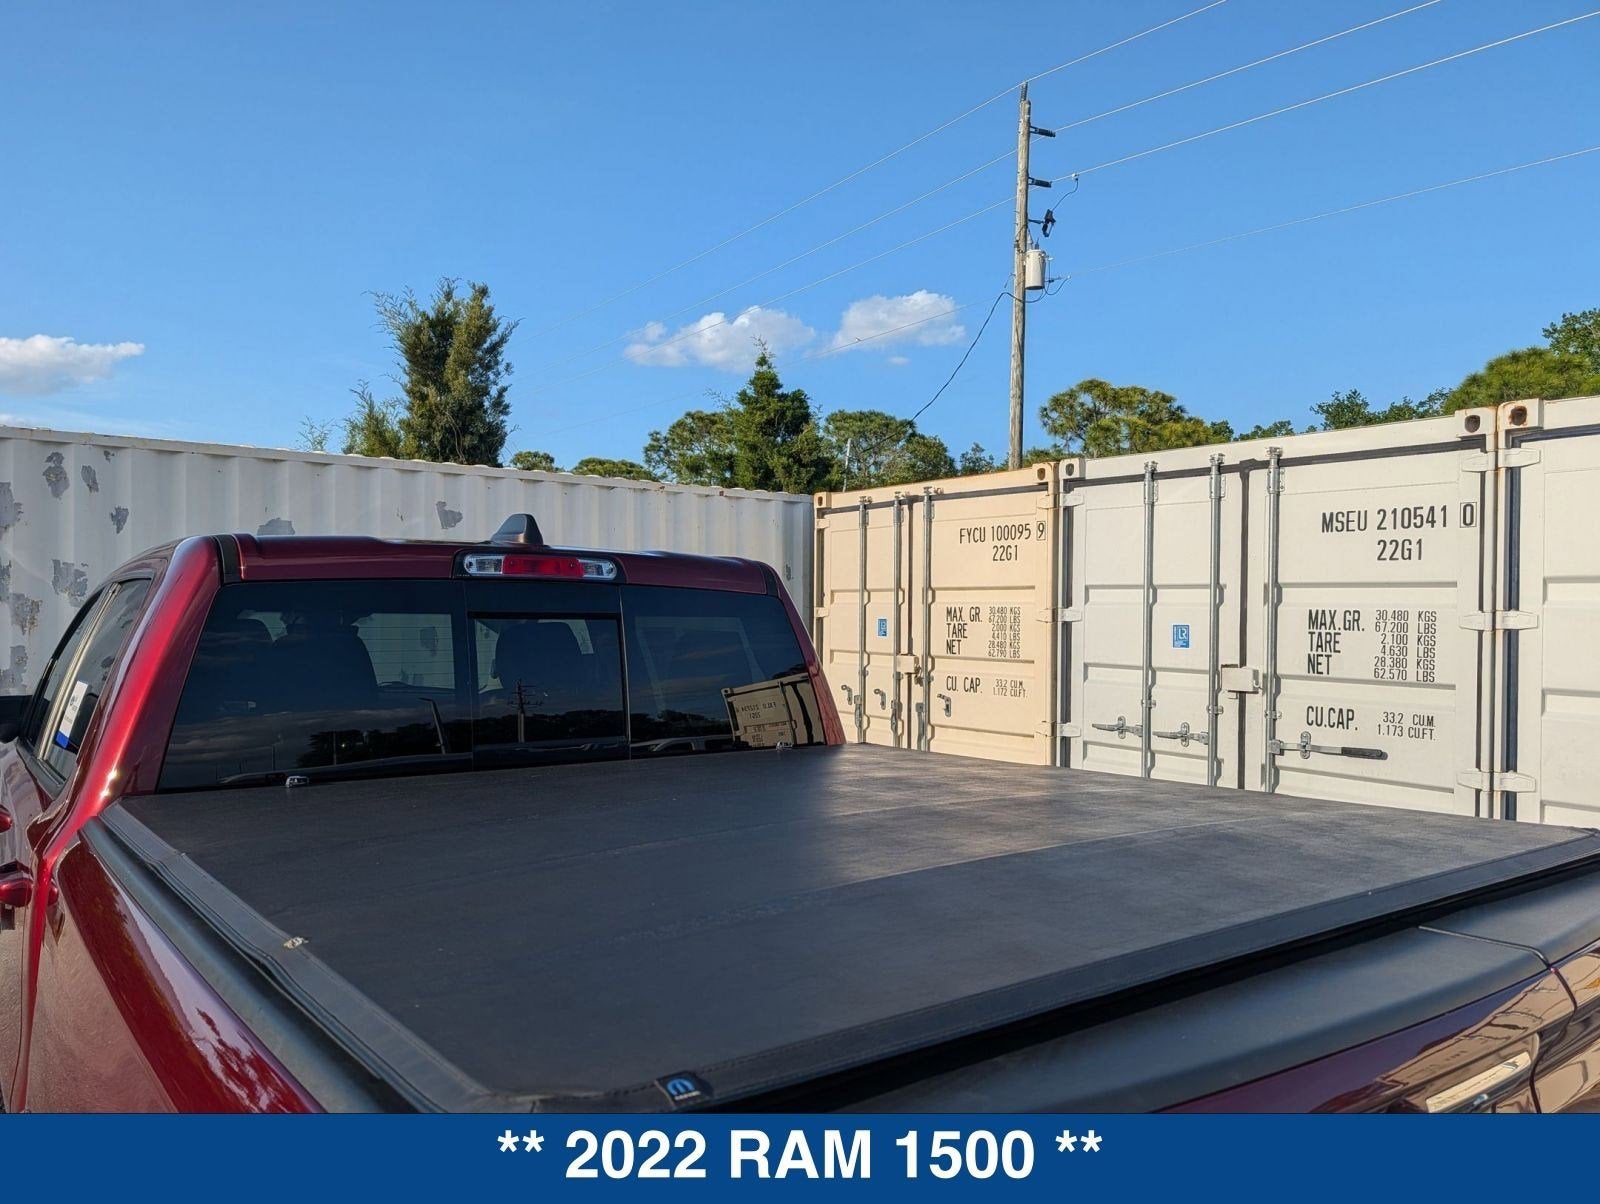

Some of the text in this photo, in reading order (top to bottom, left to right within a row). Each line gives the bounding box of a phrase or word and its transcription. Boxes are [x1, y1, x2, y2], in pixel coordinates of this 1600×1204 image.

[1322, 503, 1475, 532] MSEU 210541 0
[960, 522, 1045, 543] FYCU 100095 9
[993, 545, 1018, 561] 22G1
[1377, 538, 1423, 561] 22G1
[970, 606, 982, 622] GR.
[1010, 607, 1020, 615] KGS
[1375, 610, 1409, 621] 30.480
[1418, 610, 1437, 622] KGS
[946, 623, 968, 638] TARE
[1010, 624, 1020, 632] KGS
[1375, 622, 1436, 634] 67.200 LBS
[1010, 633, 1020, 641] LBS
[1308, 631, 1436, 653] TARE 2.100 KGS
[946, 639, 961, 655] NET
[1010, 641, 1020, 650] KGS
[1010, 650, 1020, 658] LBS
[1380, 645, 1436, 658] 4.630 LBS
[1308, 654, 1435, 675] NET 28.380 KGS
[1374, 668, 1435, 682] 62.570 LBS
[946, 676, 959, 692] CU.
[964, 677, 982, 694] CAP.
[1383, 712, 1403, 724] 33.2
[1377, 724, 1403, 737] 1.173
